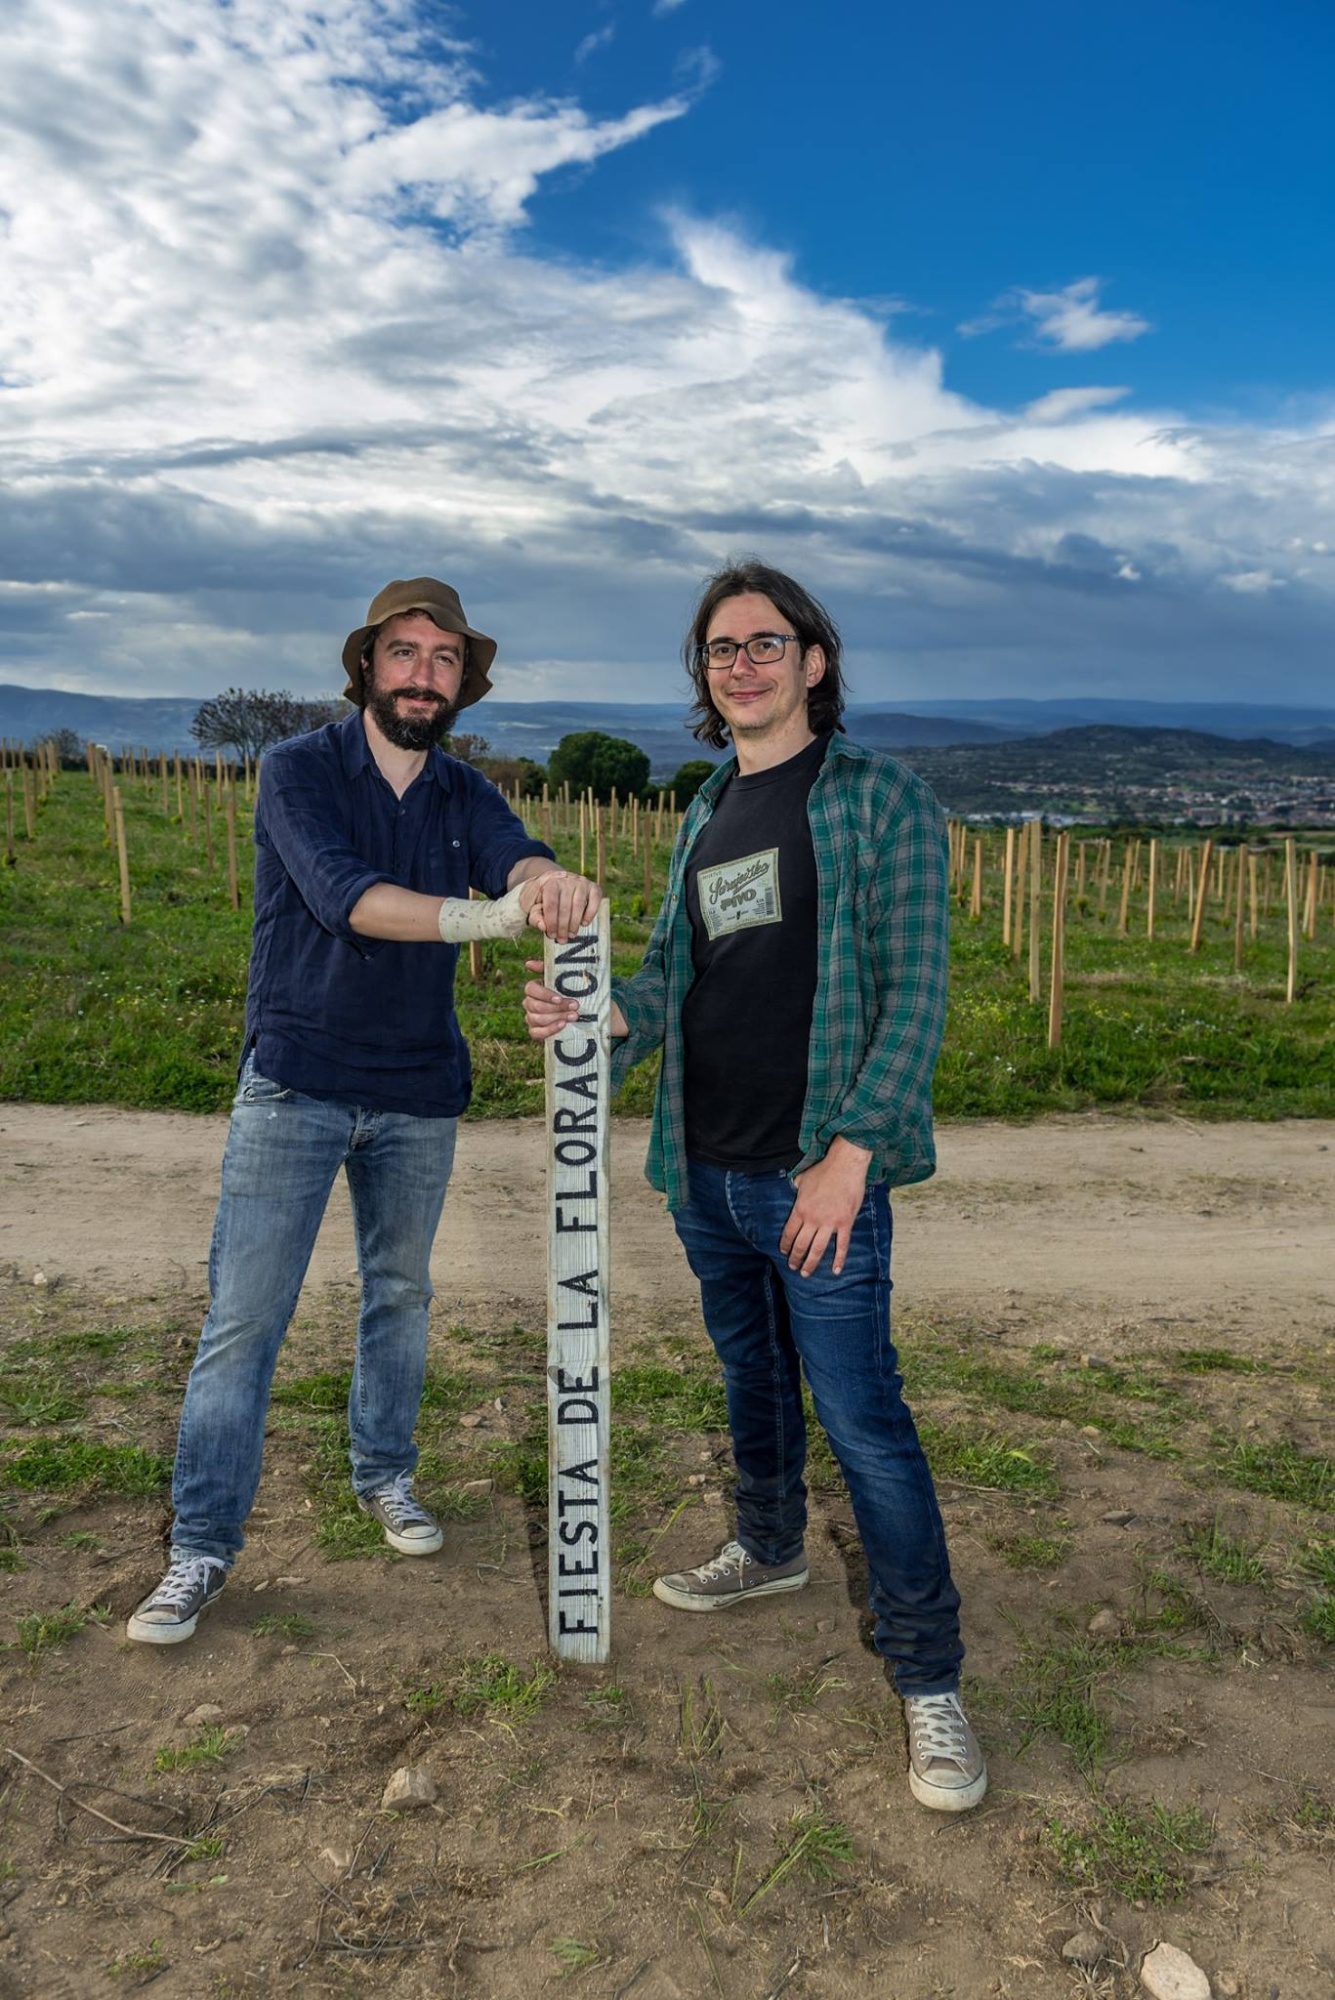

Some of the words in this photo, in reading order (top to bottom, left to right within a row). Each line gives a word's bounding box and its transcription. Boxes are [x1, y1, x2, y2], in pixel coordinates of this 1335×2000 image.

[558, 1269, 599, 1330] LA
[558, 1366, 599, 1425] DE
[558, 1459, 599, 1635] FIESTA
